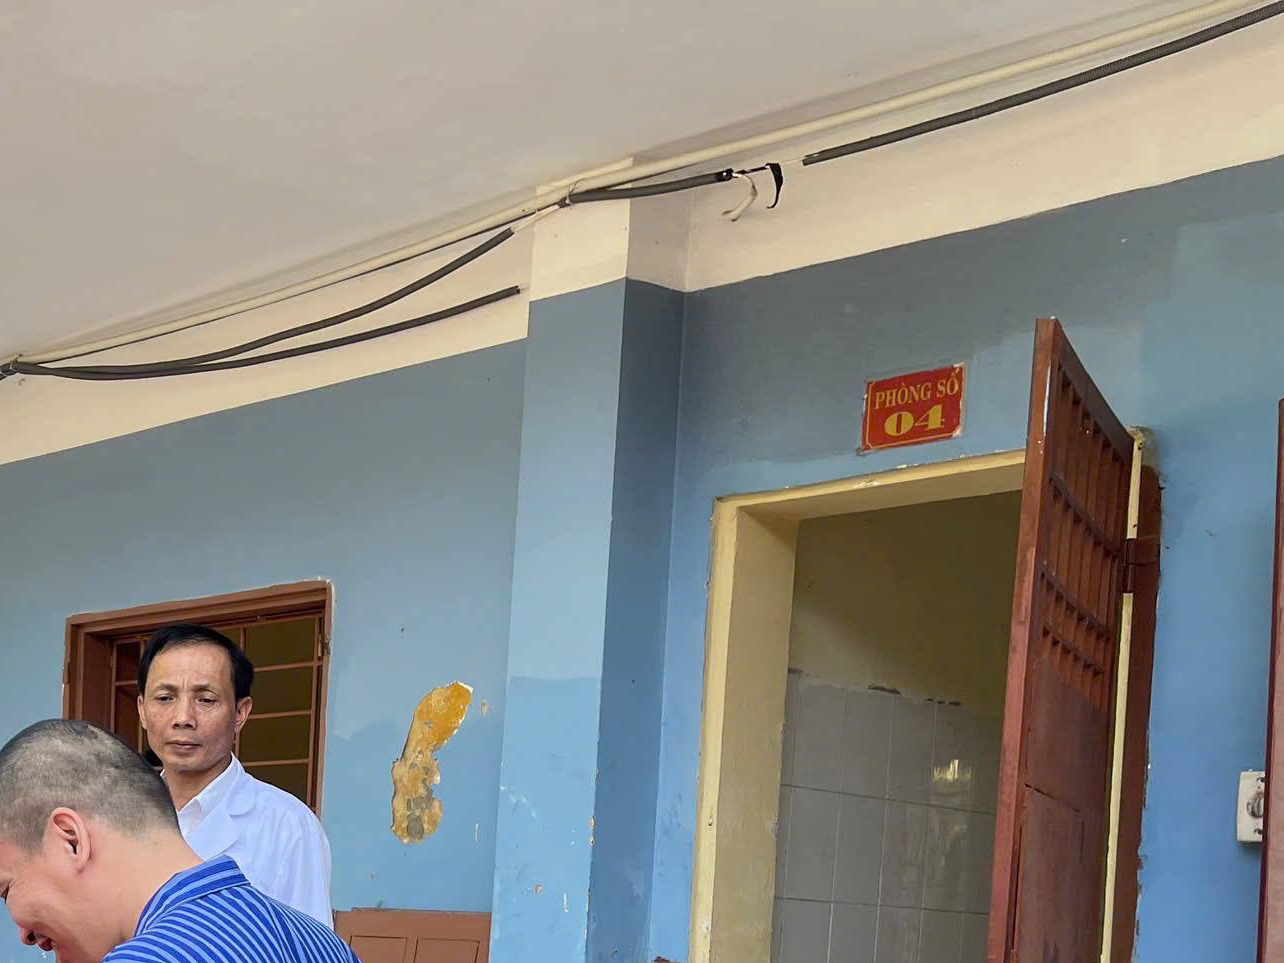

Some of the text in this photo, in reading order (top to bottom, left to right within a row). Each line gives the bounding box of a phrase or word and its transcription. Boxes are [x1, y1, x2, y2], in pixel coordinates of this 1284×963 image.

[874, 367, 960, 410] PHÒNG SỐ
[884, 404, 945, 436] 04
